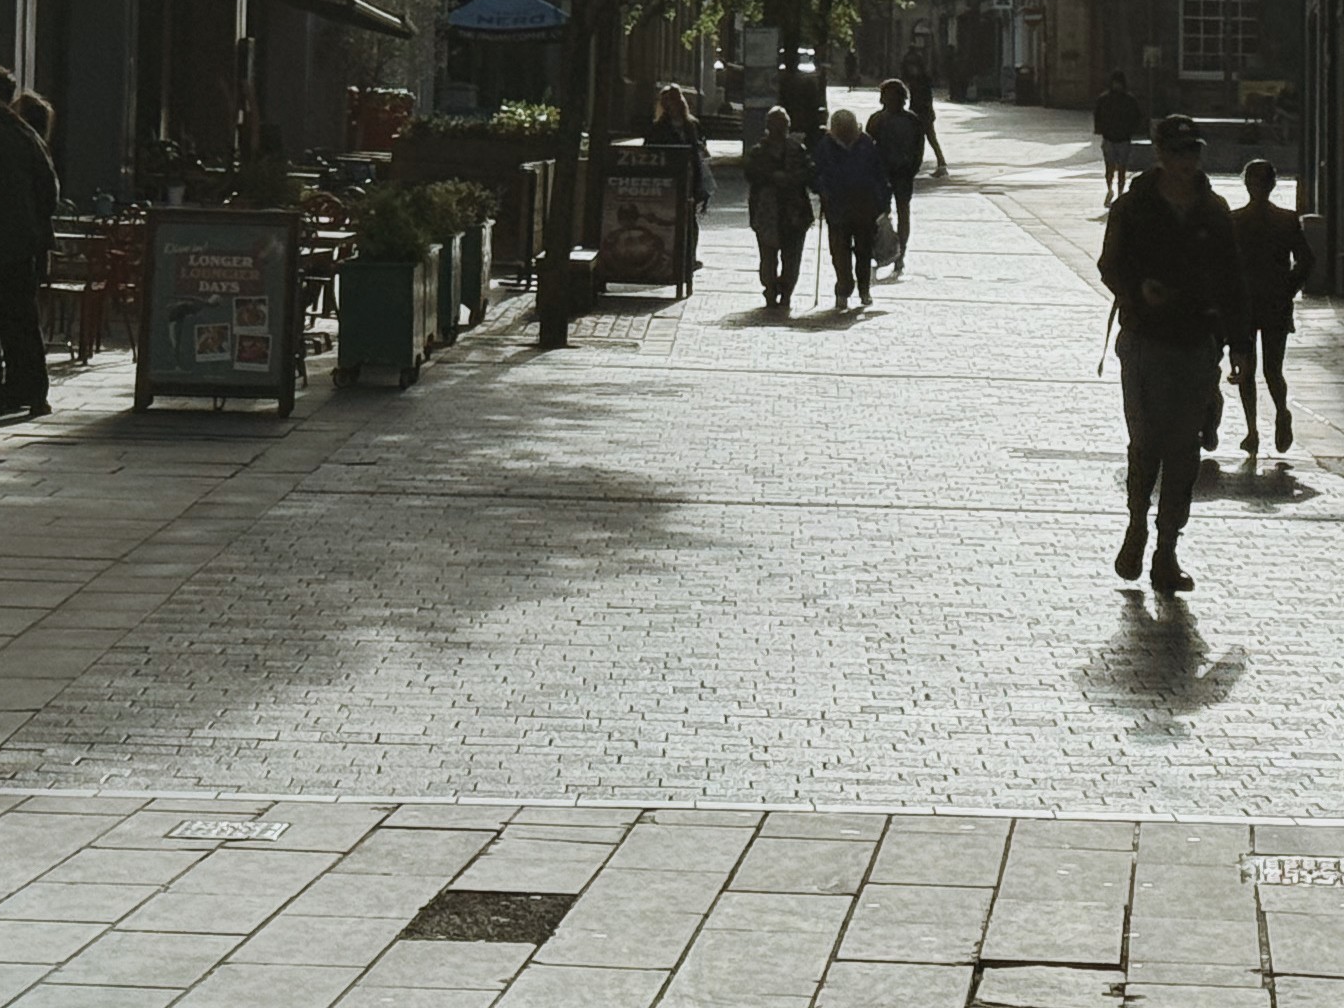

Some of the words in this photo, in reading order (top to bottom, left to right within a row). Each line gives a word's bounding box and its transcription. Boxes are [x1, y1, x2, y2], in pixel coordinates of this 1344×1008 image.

[477, 14, 546, 27] NERO
[616, 150, 666, 166] Zizzi
[607, 176, 673, 188] CHEESE
[618, 187, 662, 197] POUR
[188, 254, 254, 269] LONGER
[198, 281, 241, 294] DAYS
